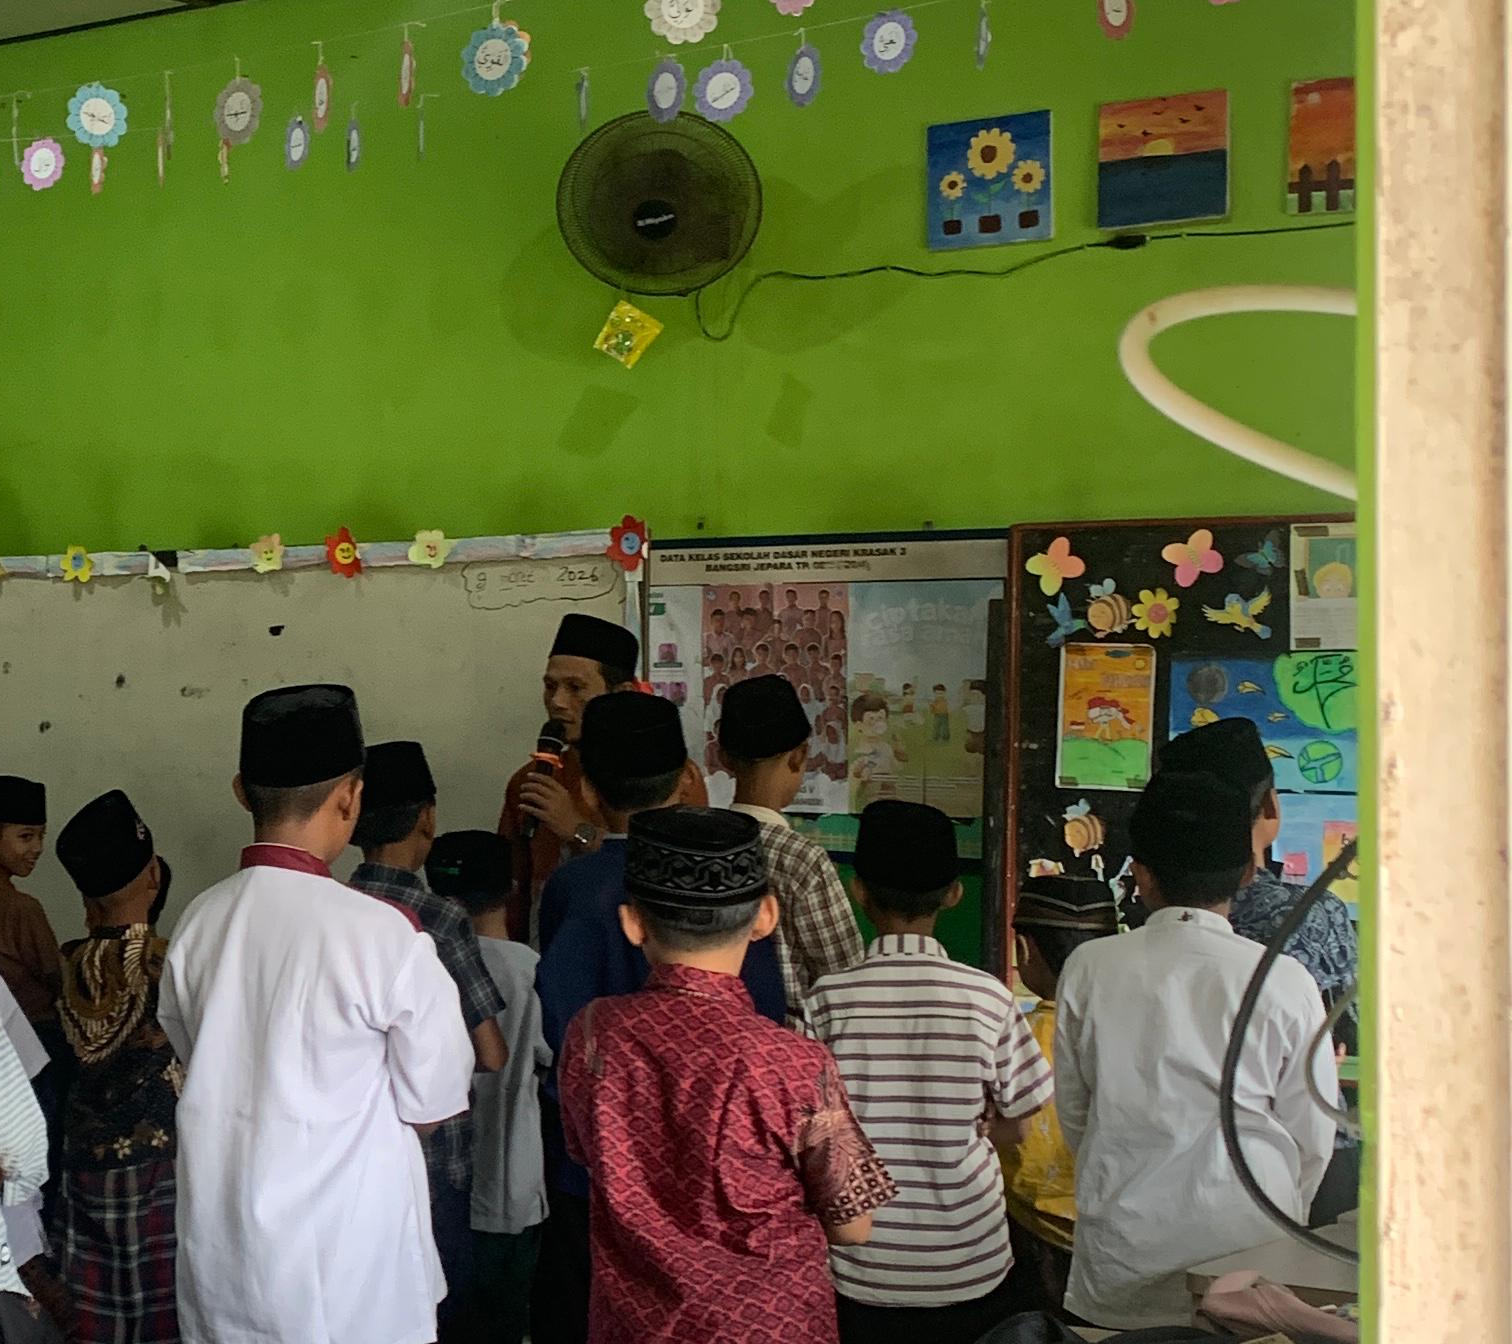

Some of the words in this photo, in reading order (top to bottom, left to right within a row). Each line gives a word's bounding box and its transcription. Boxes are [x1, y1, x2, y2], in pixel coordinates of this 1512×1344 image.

[660, 554, 686, 563] DATA
[688, 552, 720, 562] KELAS
[723, 551, 770, 561] SEKOLAH
[773, 550, 808, 560] DASAR
[556, 566, 599, 583] 2026
